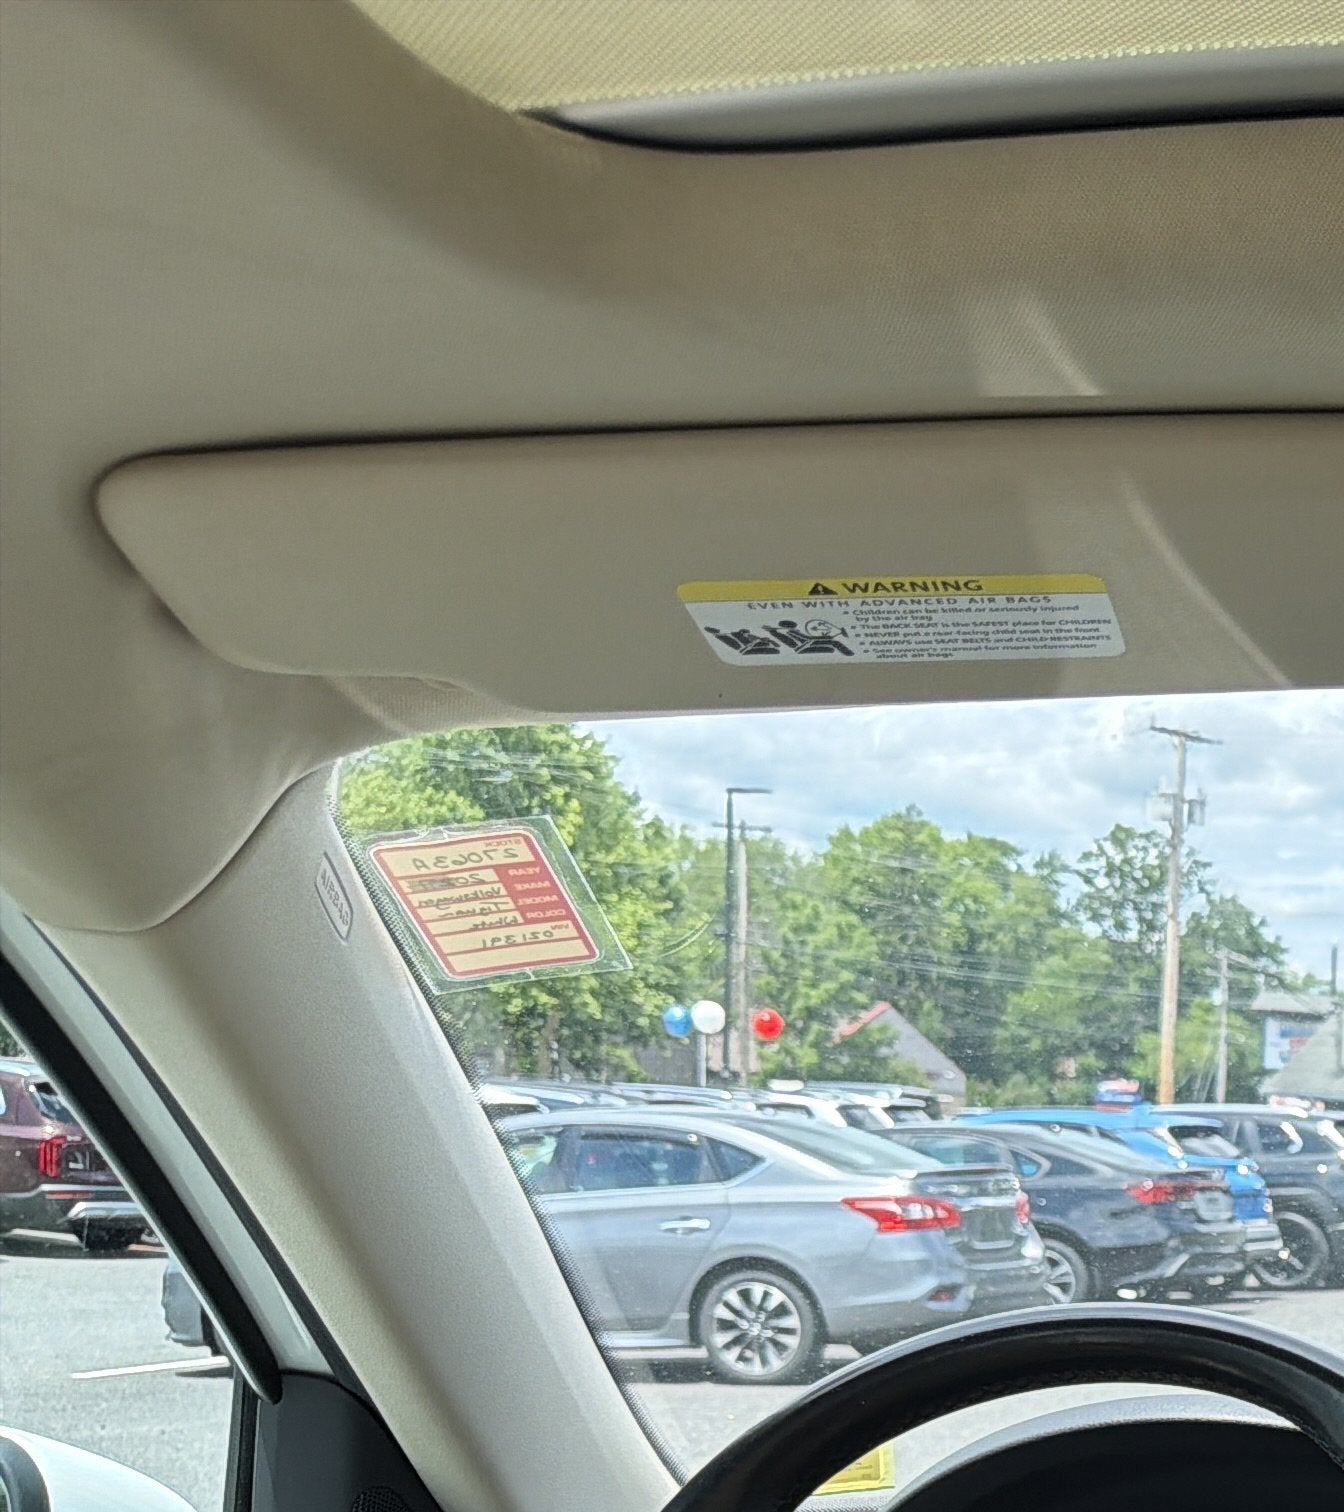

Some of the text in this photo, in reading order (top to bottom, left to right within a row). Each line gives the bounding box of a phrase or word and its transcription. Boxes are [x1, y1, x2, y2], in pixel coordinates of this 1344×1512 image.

[841, 580, 983, 593] WARNING
[746, 602, 793, 610] EVEN
[801, 600, 850, 608] WITH
[860, 598, 957, 607] ADVANCED
